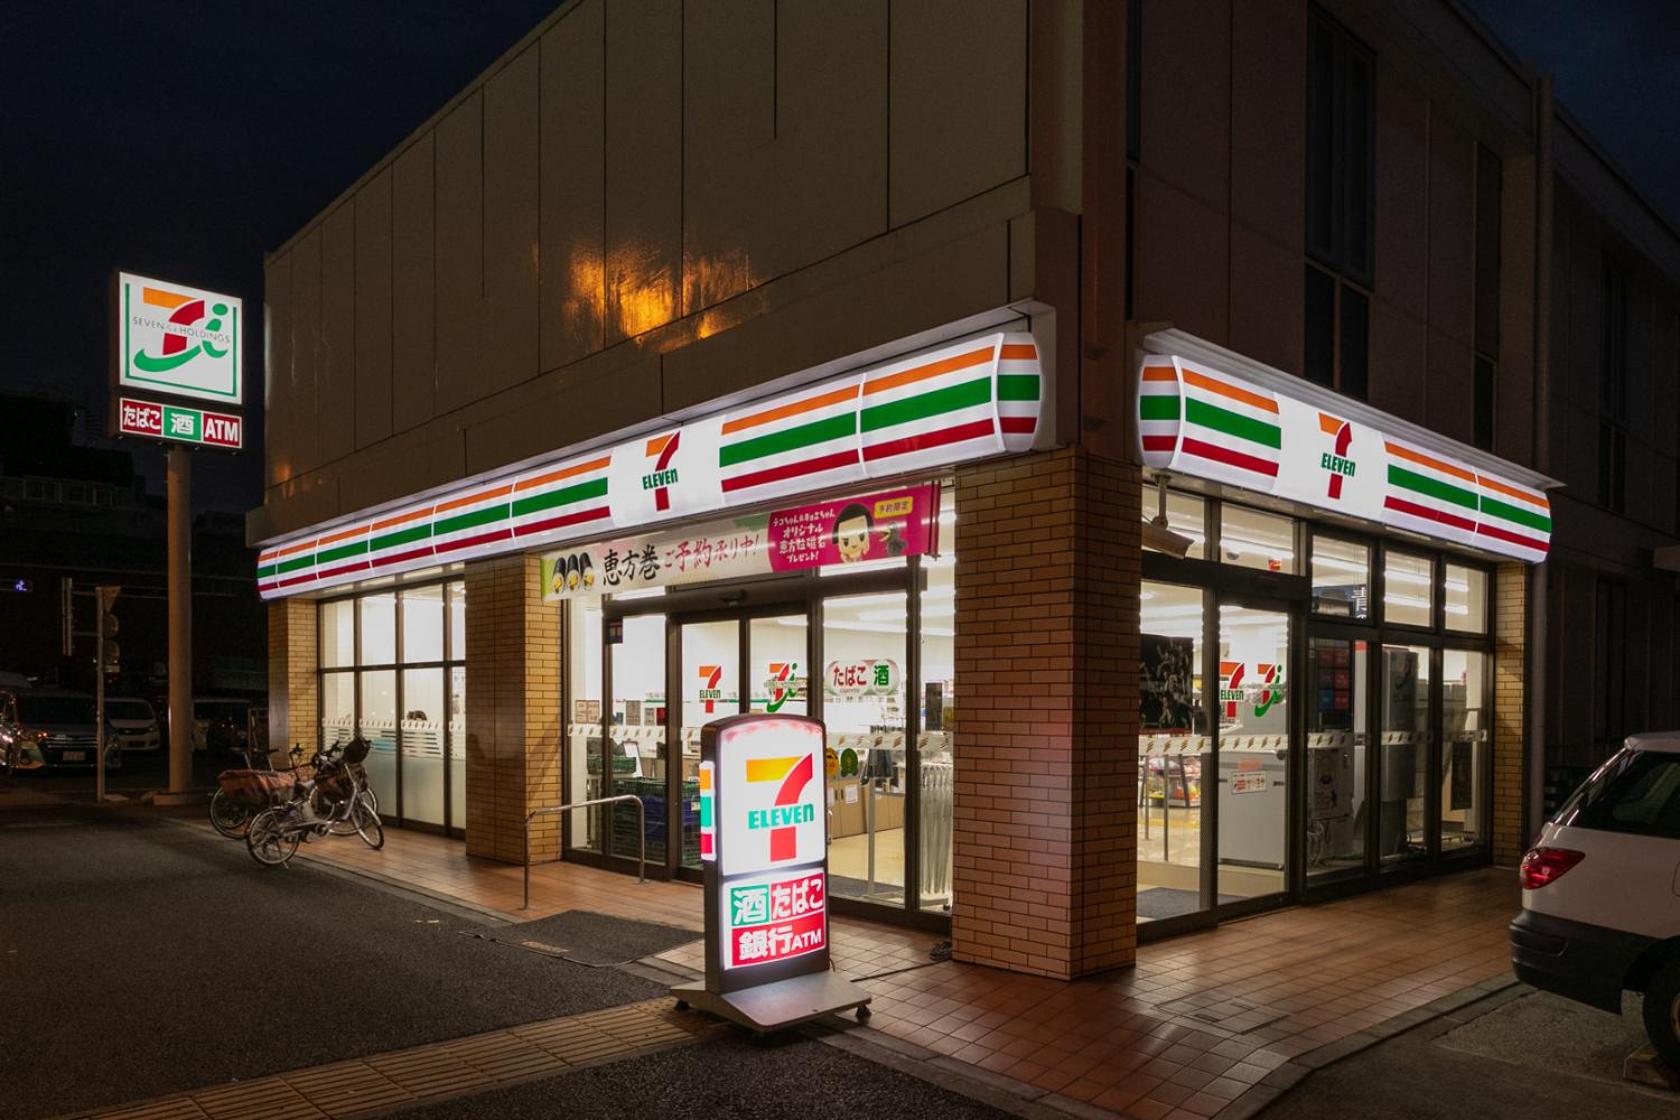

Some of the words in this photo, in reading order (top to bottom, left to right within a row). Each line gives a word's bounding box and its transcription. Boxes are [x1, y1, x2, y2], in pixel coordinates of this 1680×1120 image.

[133, 316, 164, 330] SEVEN
[179, 327, 230, 343] HOLDINGS
[123, 405, 161, 430] たばこ
[170, 412, 196, 436] 酒
[204, 418, 238, 442] ATM
[646, 430, 681, 511] 7
[1318, 412, 1352, 500] 7
[699, 665, 721, 713] 7
[833, 665, 867, 686] たばこ
[873, 664, 889, 686] 酒
[1219, 662, 1244, 717] 7
[746, 752, 813, 862] 7
[733, 888, 768, 925] 酒
[771, 877, 823, 920] たばこ
[738, 925, 793, 960] 銀行
[791, 933, 822, 952] ATM
